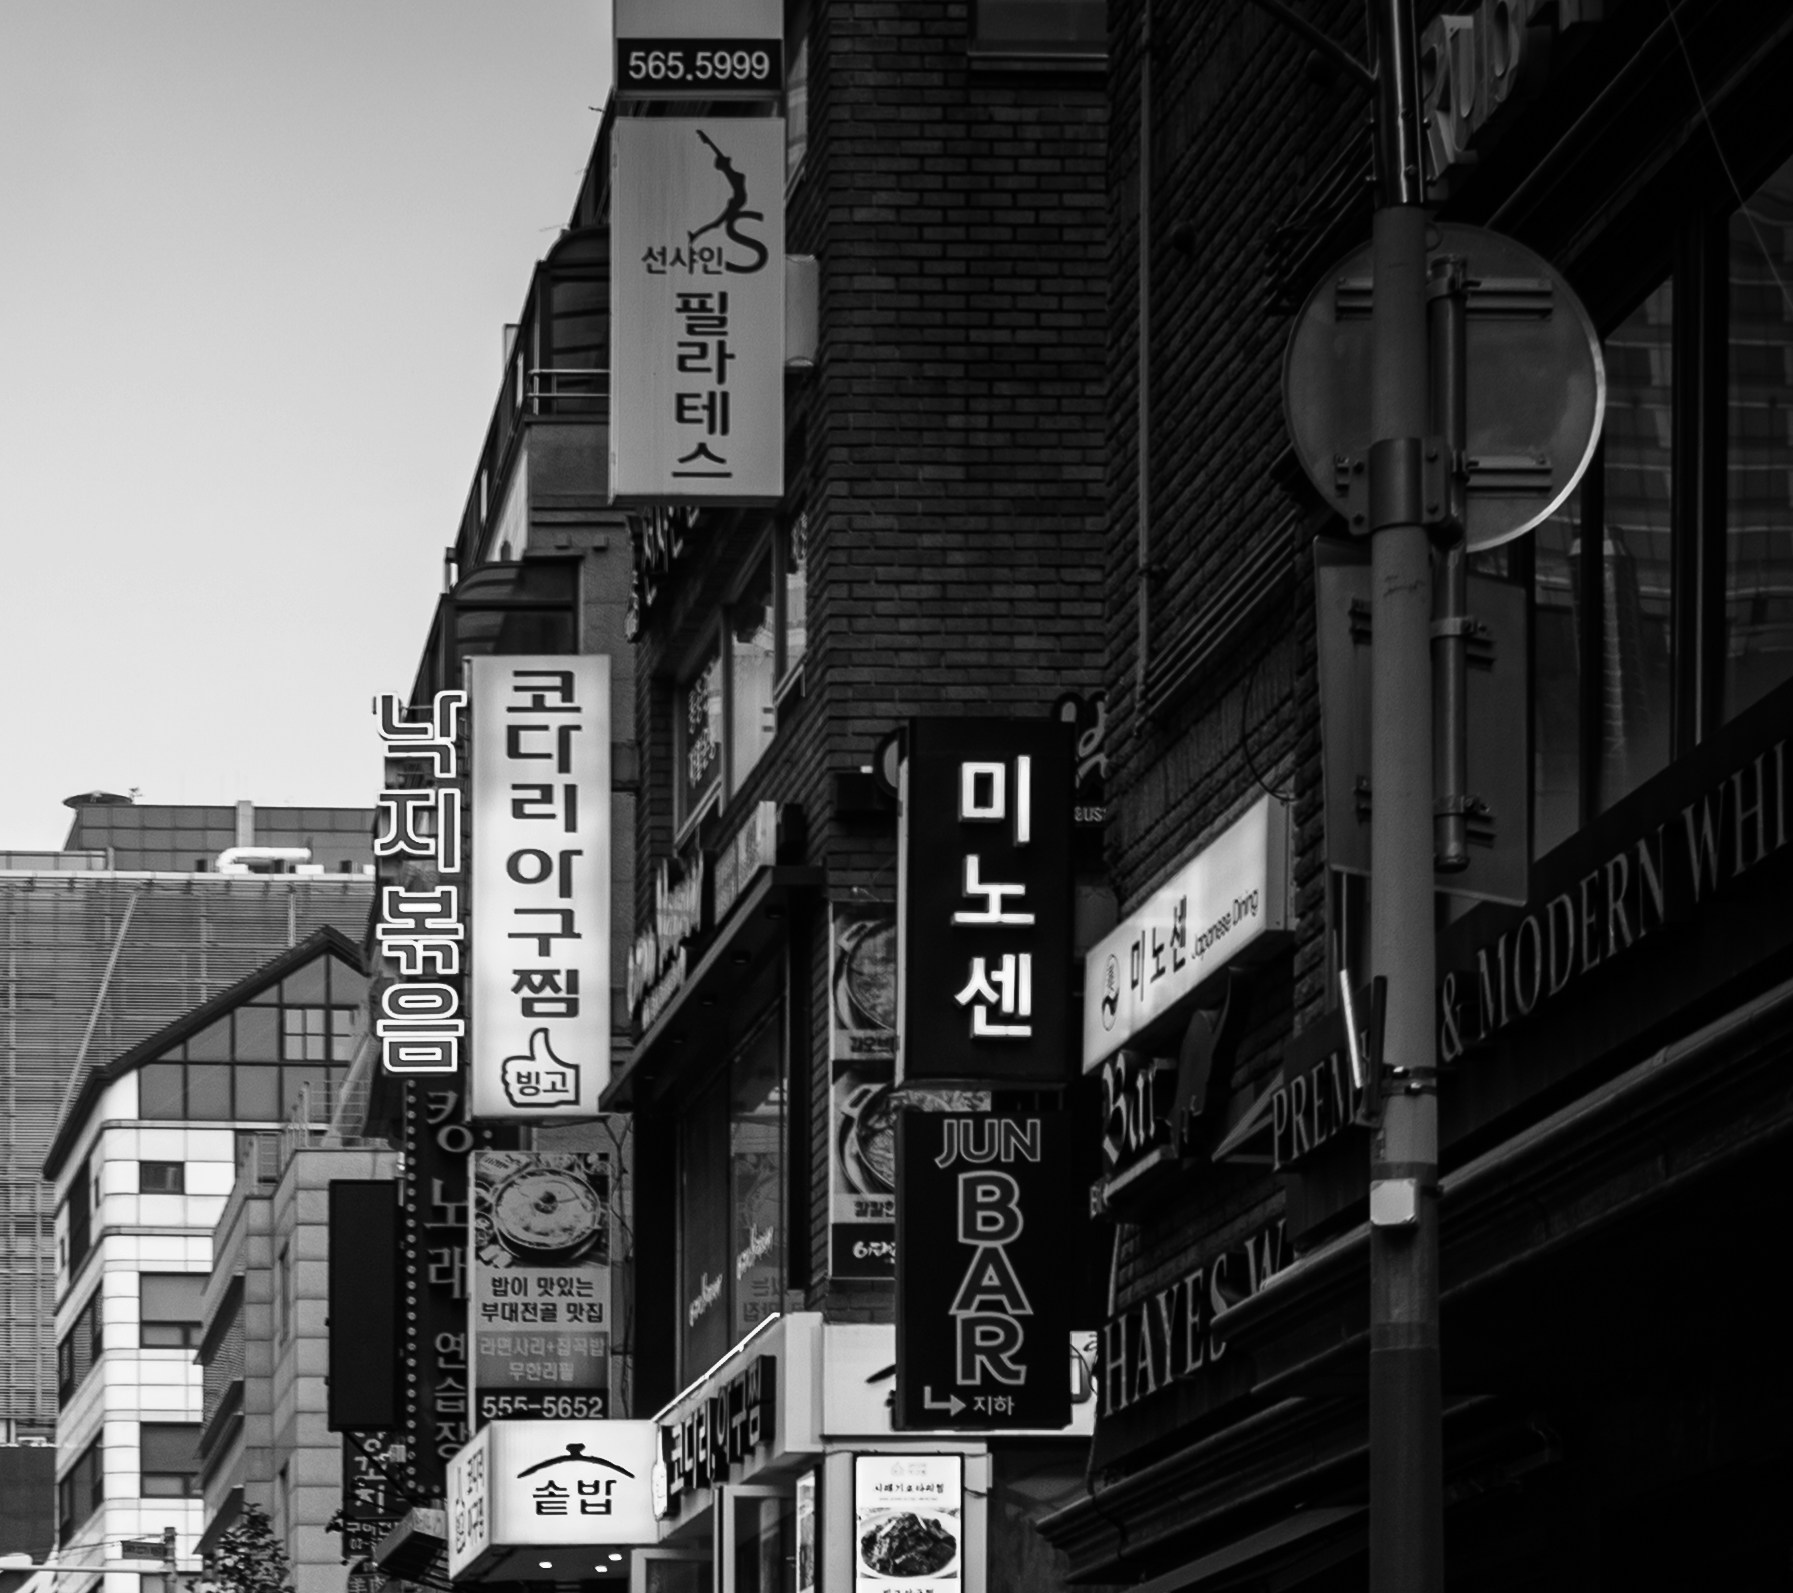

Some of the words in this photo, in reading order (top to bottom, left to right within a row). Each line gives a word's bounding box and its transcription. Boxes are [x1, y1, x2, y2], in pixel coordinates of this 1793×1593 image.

[628, 50, 770, 82] 565.5999
[641, 246, 723, 275] 선샤인
[672, 291, 735, 479] 필라테스
[507, 670, 583, 1018] 코다리아구찜
[373, 689, 468, 1073] 낙지볶음
[950, 753, 1037, 1041] 미노센
[1131, 895, 1188, 1001] 미노센
[1191, 911, 1231, 959] Japanese
[1231, 889, 1259, 930] Dining
[1476, 822, 1666, 1041] MODERN
[516, 1071, 570, 1096] 빙고
[1271, 1028, 1373, 1172] PREM
[934, 1118, 1041, 1170] JUN
[481, 1303, 559, 1323] 부대전골
[566, 1303, 604, 1323] 맛집
[491, 1277, 528, 1297] 밥이
[536, 1277, 594, 1297] 맛있는
[948, 1170, 1034, 1386] BAR
[1103, 1268, 1228, 1420] HAYES
[480, 1396, 605, 1419] 555-5652
[962, 1395, 1015, 1416] 지하
[532, 1479, 617, 1515] 솥밥
